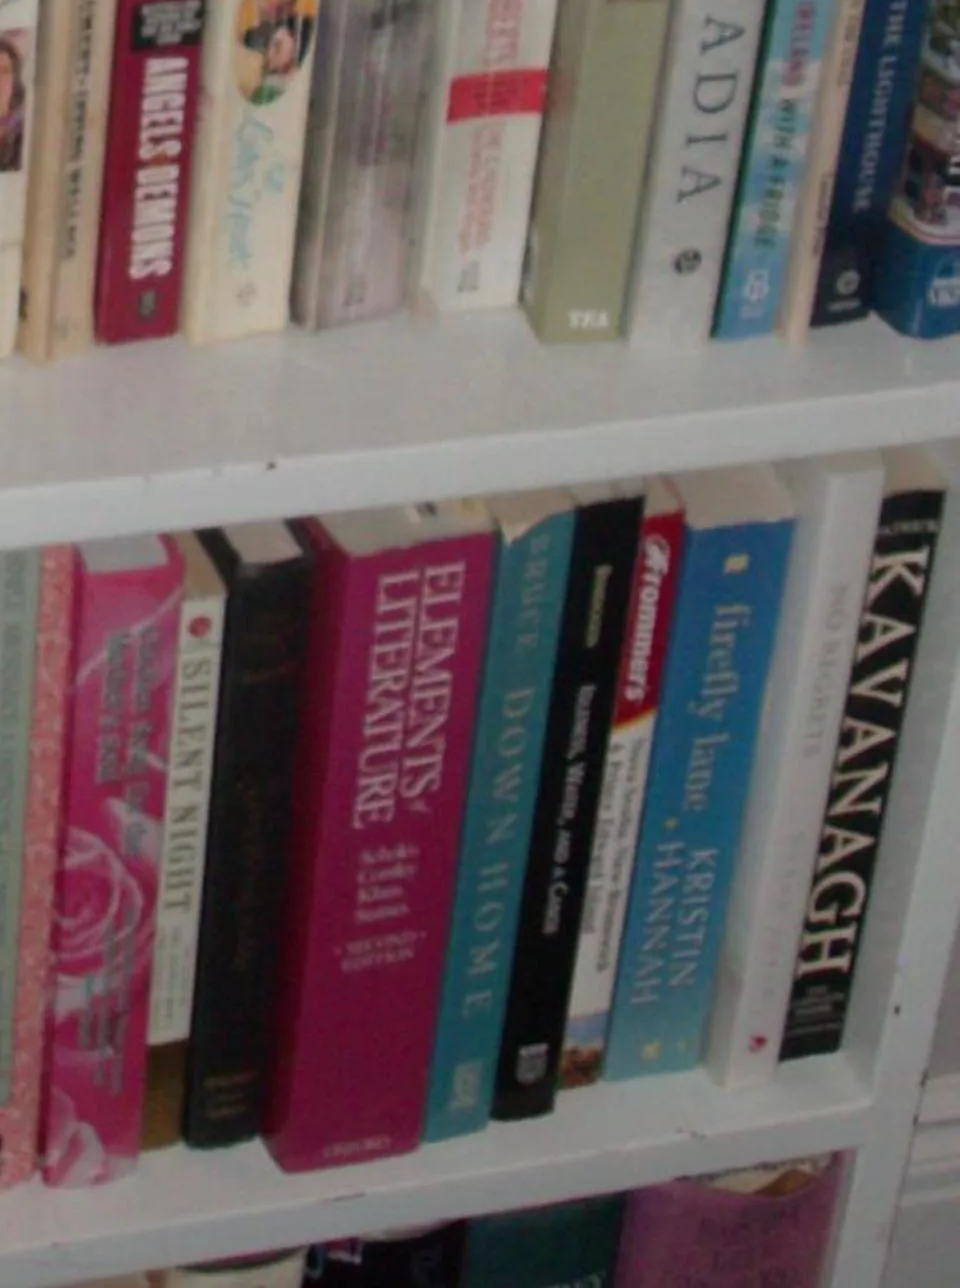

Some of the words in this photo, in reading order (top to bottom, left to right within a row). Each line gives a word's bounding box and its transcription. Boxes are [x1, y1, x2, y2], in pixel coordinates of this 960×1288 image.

[138, 55, 190, 158] ANGELS
[782, 0, 821, 88] IRELAND
[852, 53, 900, 214] LIGHTHOUSE
[128, 164, 181, 280] DEMONS
[752, 169, 791, 251] FRIDGE
[397, 559, 467, 798] ELEMENTS
[624, 531, 674, 701] Frommer's
[687, 602, 754, 720] firefly
[825, 588, 851, 633] NO
[165, 656, 213, 792] SILENT
[352, 567, 421, 830] LITERATURE
[484, 685, 535, 846] DOWN
[795, 541, 931, 981] KAVANAGH
[802, 639, 844, 761] REGRETS
[680, 730, 732, 814] lane
[162, 799, 207, 914] NIGHT
[630, 839, 687, 1007] HANNAH
[665, 846, 721, 989] KRISTIN
[457, 859, 508, 1020] HOME
